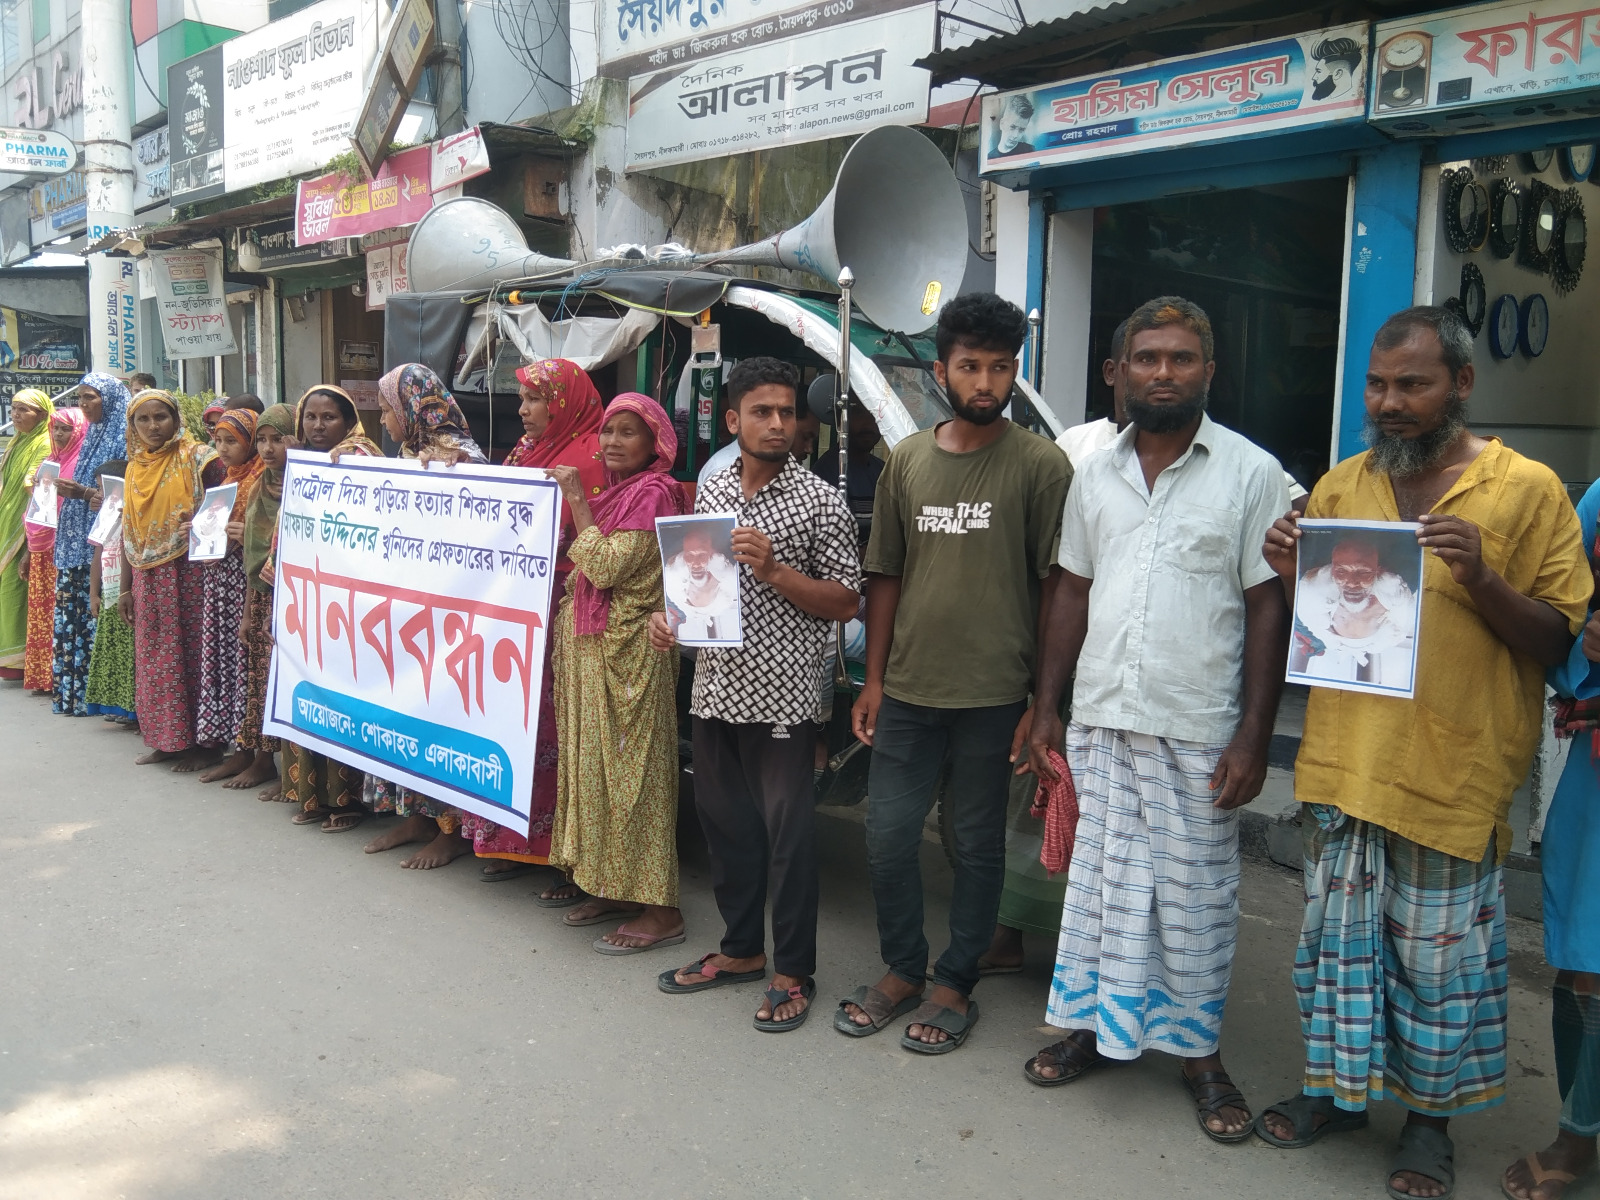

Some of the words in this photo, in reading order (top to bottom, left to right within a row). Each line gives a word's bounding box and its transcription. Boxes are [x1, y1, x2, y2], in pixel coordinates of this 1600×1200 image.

[227, 48, 277, 90] নাওশাদ
[278, 35, 307, 80] ফুল
[309, 16, 355, 61] বিতান
[649, 49, 668, 65] শহীদ
[672, 46, 686, 60] ডাঃ
[690, 34, 728, 55] জিকরুল
[731, 30, 748, 45] হক
[751, 21, 778, 38] রোড,
[1456, 7, 1600, 78] ফার
[677, 48, 888, 120] আলাপন
[680, 63, 744, 88] দৈনিক
[1052, 79, 1160, 125] হাসিম
[1167, 55, 1290, 104] সেলুন
[747, 115, 766, 124] সব
[771, 103, 819, 119] মানুষের
[825, 97, 847, 108] সব
[853, 90, 883, 103] খবর
[800, 101, 914, 131] alapon.news@gmail.com
[1086, 123, 1117, 136] রহমান
[6, 143, 69, 157] PHARMA
[304, 196, 334, 222] সুবিধা
[302, 217, 329, 238] ডাবল
[122, 261, 133, 279] RL
[123, 295, 136, 373] PHARMA
[168, 312, 224, 331] স্ট্যাম্প
[206, 333, 222, 342] যায়
[19, 354, 53, 369] 10%
[107, 339, 121, 369] ফার্মা
[291, 471, 336, 503] পেট্রোল
[337, 475, 368, 506] দিয়ে
[373, 480, 410, 514] পুড়িয়ে
[414, 489, 454, 519] হত্যার
[458, 486, 502, 523] শিকার
[507, 499, 535, 535] বৃদ্ধ
[922, 505, 954, 518] WHERE
[956, 501, 992, 519] THE
[915, 515, 968, 534] TRAIL
[966, 519, 990, 529] ENDS
[320, 509, 380, 552] উদ্দিনের
[383, 526, 424, 561] খুনিদের
[428, 539, 494, 573] গ্রেফতারের
[500, 543, 549, 579] দাবিতে
[281, 553, 544, 735] মানববন্ধন
[361, 720, 419, 760] শোকাহত
[424, 743, 504, 791] এলাকাবাসী
